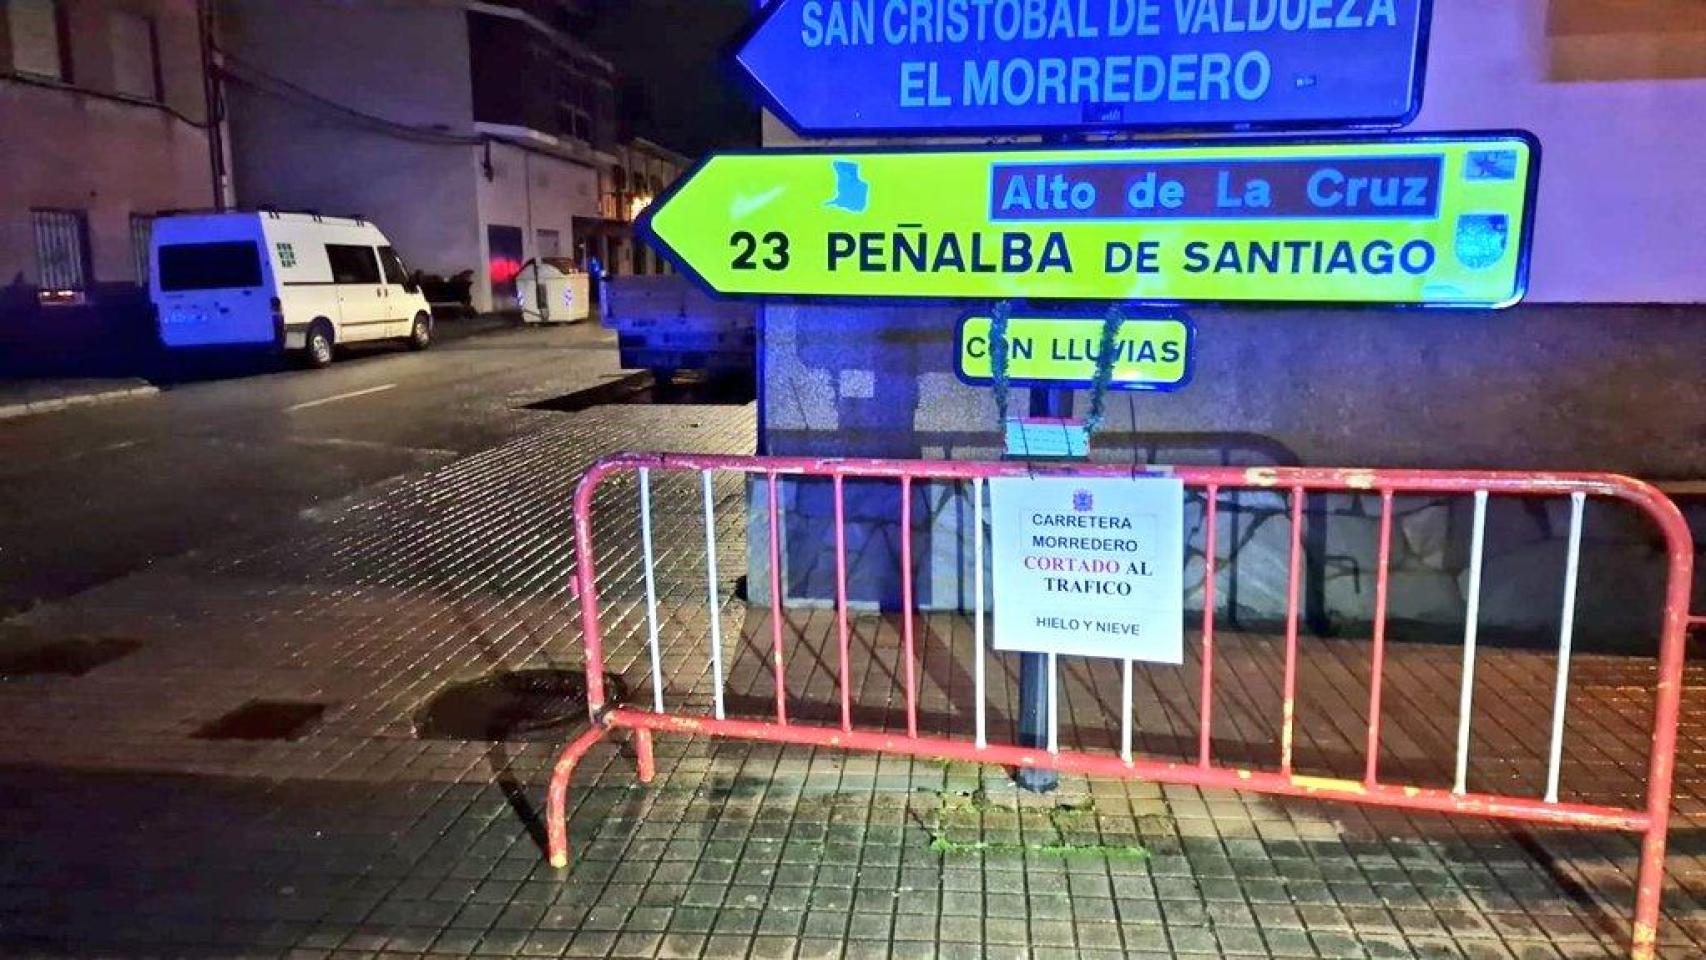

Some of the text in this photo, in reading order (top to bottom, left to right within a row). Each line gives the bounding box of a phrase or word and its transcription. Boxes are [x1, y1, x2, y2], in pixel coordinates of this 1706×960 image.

[801, 0, 1397, 48] SAN CRISTOBAL DE VALDUEZA
[900, 51, 1271, 107] EL MORREDERO
[1002, 168, 1428, 210] Alto de La Cruz
[730, 223, 1436, 275] 23 PEÑALBA DE SANTIAGO
[1032, 513, 1133, 530] CARRETERA
[1032, 535, 1138, 552] MORREDERO
[1024, 556, 1153, 576] CORTADO AL
[1043, 577, 1132, 597] TRAFICO
[1036, 616, 1140, 636] HIELO Y NIEVE
